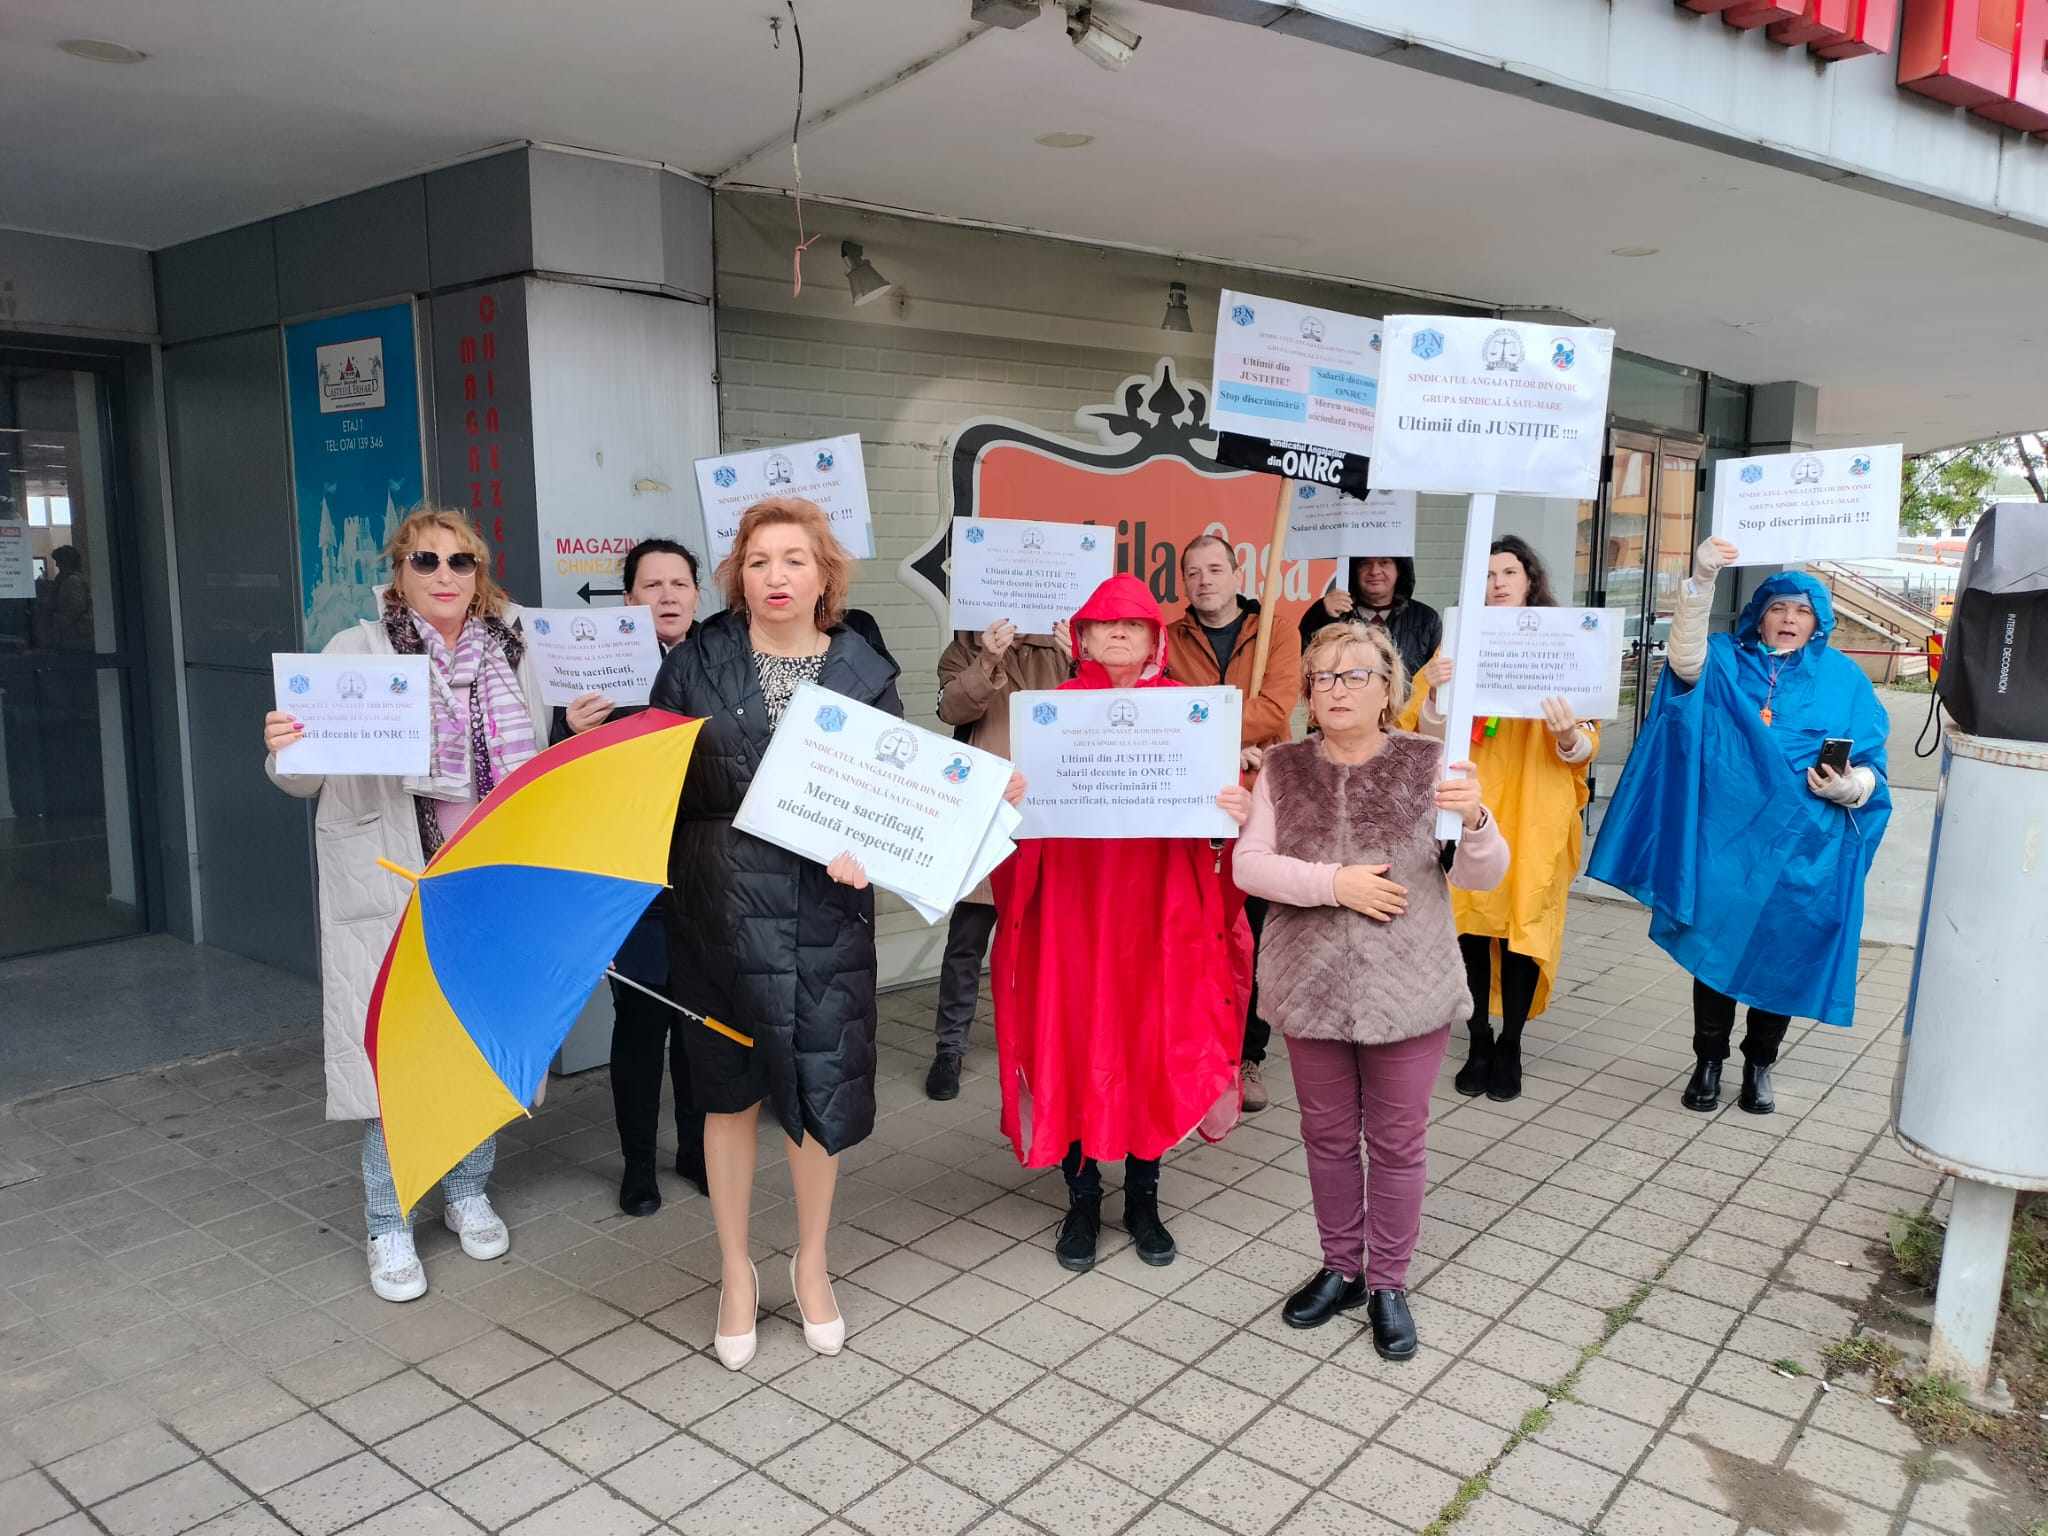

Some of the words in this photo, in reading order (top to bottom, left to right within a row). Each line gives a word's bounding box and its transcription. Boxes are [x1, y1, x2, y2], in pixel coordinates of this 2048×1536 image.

[1407, 373, 1469, 386] SINDICATUL
[1220, 388, 1240, 404] Stop
[342, 420, 358, 433] ETAJ
[1397, 414, 1452, 432] Ultimii
[1457, 418, 1481, 434] din
[1485, 420, 1560, 440] JUSTIȚIE
[371, 435, 384, 449] 346
[1267, 455, 1282, 468] din
[1281, 450, 1345, 484] ONRC
[1738, 519, 1767, 532] Stop
[1769, 513, 1852, 530] discriminării
[1855, 511, 1871, 524] !!!
[2004, 612, 2017, 645] INTERIOR
[1998, 646, 2013, 694] DECORATION
[321, 730, 359, 740] decente
[373, 729, 407, 740] ONRC
[408, 728, 421, 740] !!!
[1061, 754, 1094, 764] Ultimii
[1096, 753, 1112, 764] din
[1056, 768, 1088, 778] Salarii
[1090, 768, 1126, 778] decente
[1140, 767, 1173, 777] ONRC
[1071, 782, 1093, 793] Stop
[803, 782, 850, 810] Mereu
[1026, 797, 1057, 806] Mereu
[776, 798, 842, 833] niciodată
[844, 826, 914, 864] respectați
[915, 851, 934, 870] !!!
